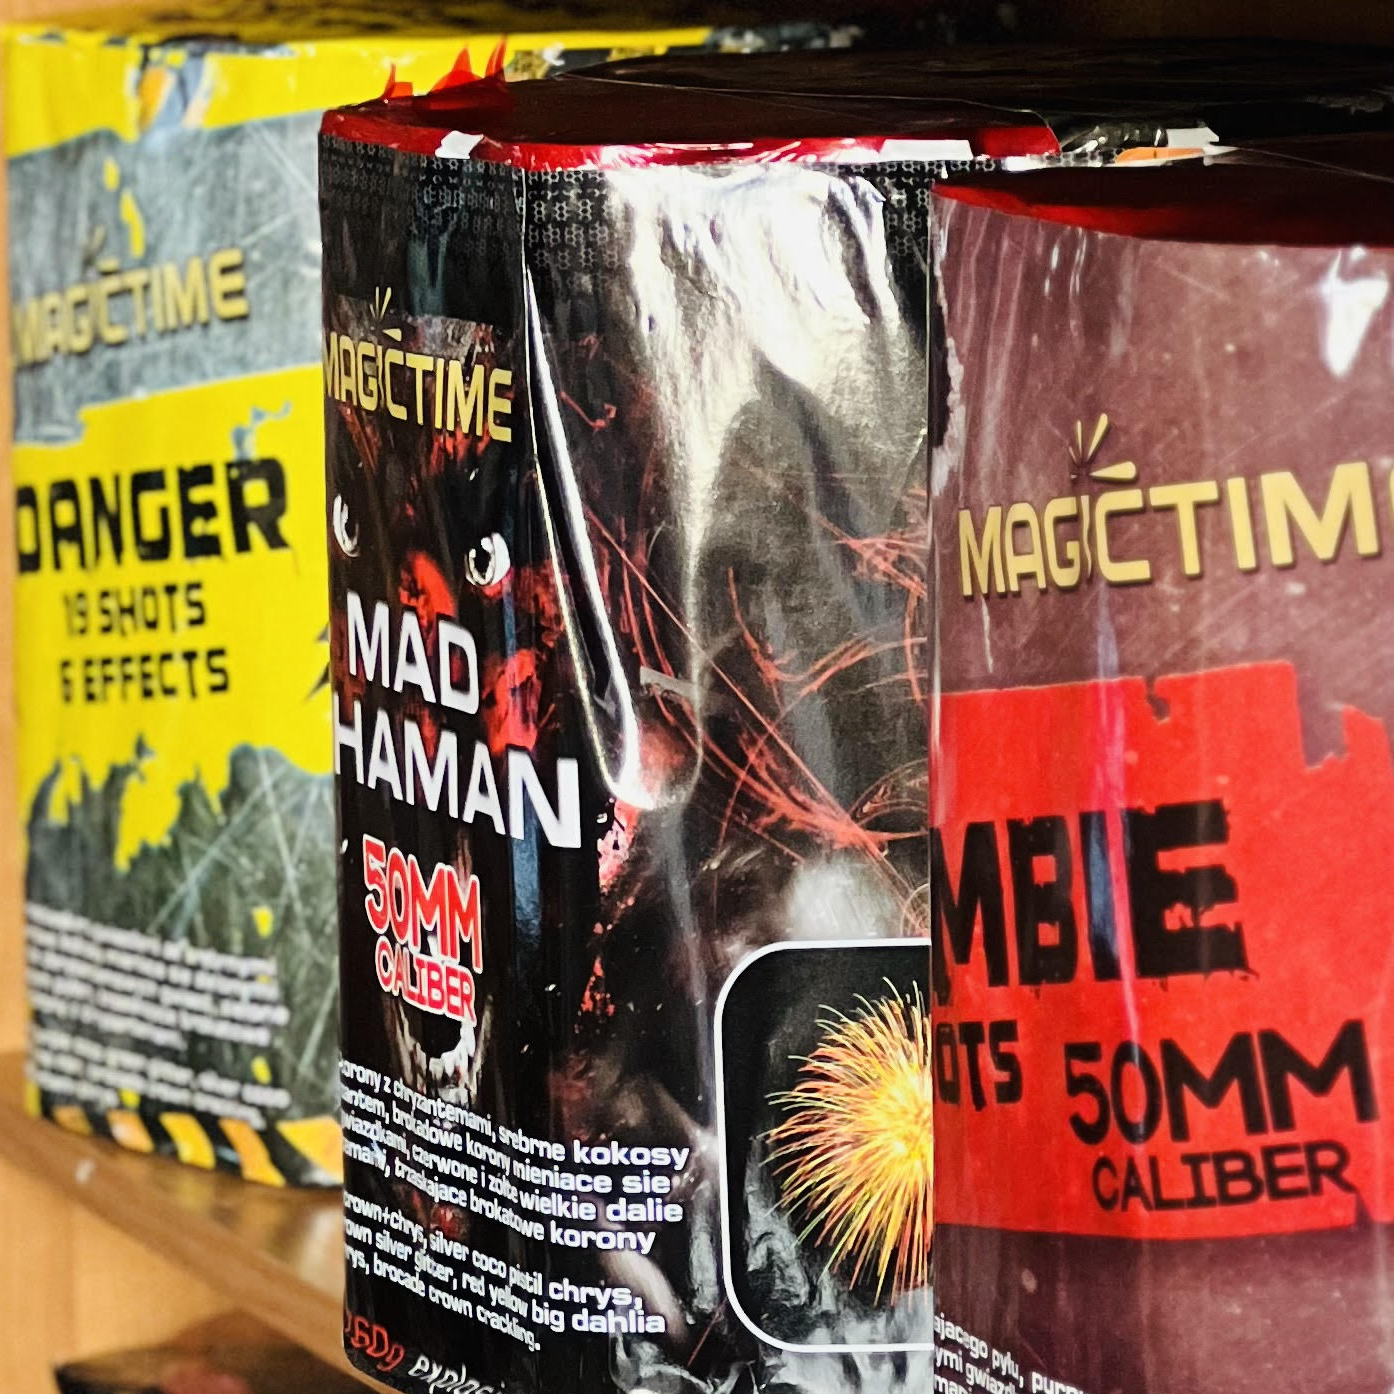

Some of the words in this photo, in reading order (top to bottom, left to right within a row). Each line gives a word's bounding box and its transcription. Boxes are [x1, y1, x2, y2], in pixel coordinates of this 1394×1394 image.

[15, 457, 291, 576] DANGER
[957, 460, 1394, 600] MAGICTIM
[100, 582, 206, 637] SHOTS
[347, 590, 480, 715] MAD
[84, 647, 230, 703] EFFECTS
[361, 833, 485, 974] 50MM
[374, 934, 477, 1027] CALIBER
[1063, 1018, 1380, 1146] 50MM
[512, 1157, 613, 1194] mieniace
[621, 1169, 672, 1194] sie
[572, 1138, 690, 1172] kokosy
[1090, 1139, 1361, 1213] CALIBER
[519, 1188, 597, 1221] wielkie
[606, 1197, 684, 1223] dalie
[550, 1219, 657, 1255] korony
[373, 1252, 426, 1298] brocade
[428, 1284, 474, 1319] crown
[475, 1304, 541, 1352] crackling.
[375, 1228, 413, 1262] silver
[461, 1271, 486, 1297] red
[531, 1298, 566, 1333] big
[571, 1308, 667, 1335] dahlia
[429, 1229, 470, 1262] silver
[472, 1249, 507, 1280] coco
[548, 1277, 644, 1311] chrys,
